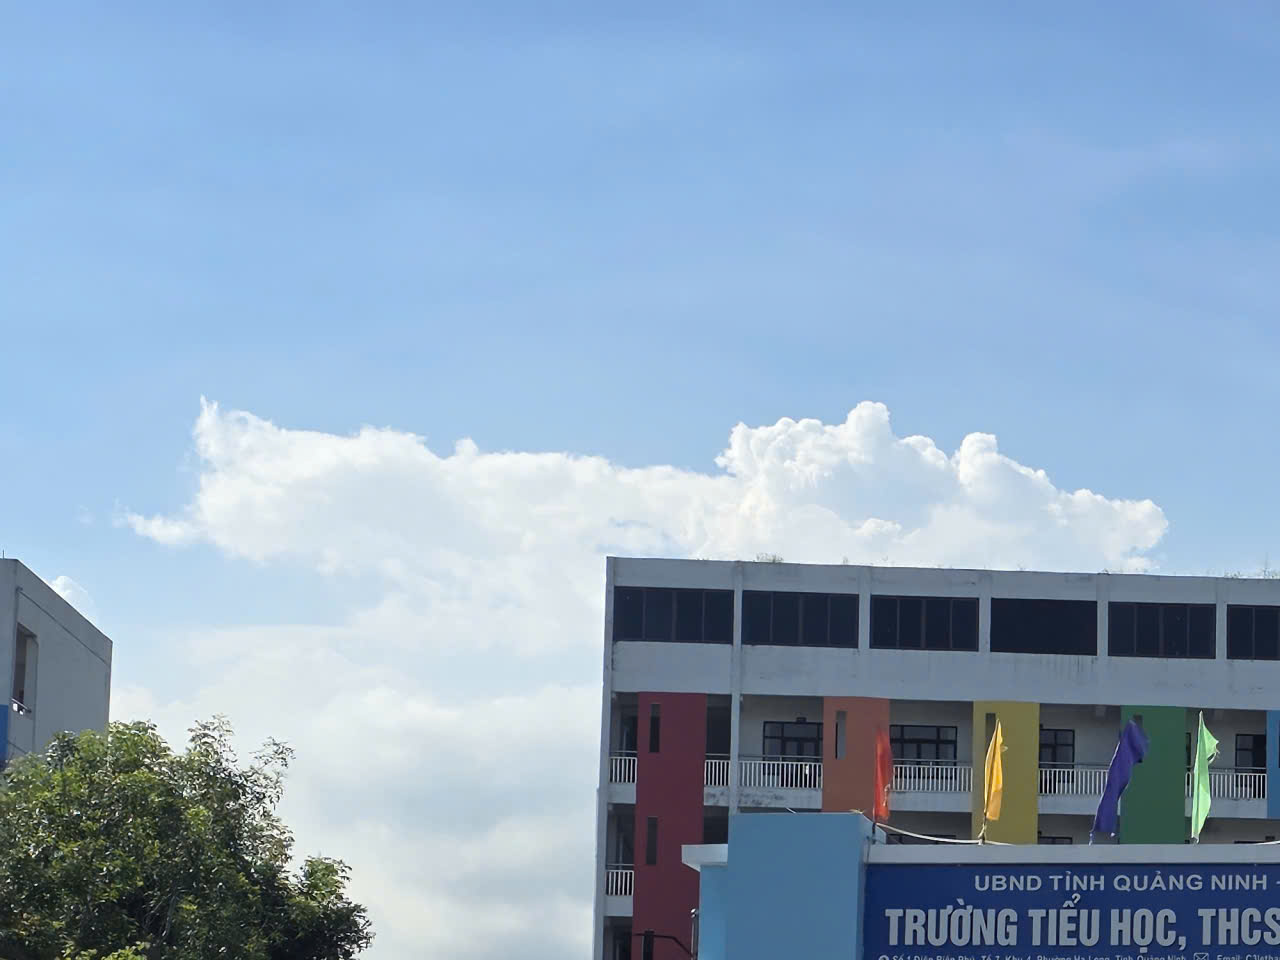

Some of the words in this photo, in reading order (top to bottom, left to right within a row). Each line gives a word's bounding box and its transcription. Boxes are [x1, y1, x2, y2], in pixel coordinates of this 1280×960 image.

[974, 874, 1042, 892] UBND
[1048, 870, 1105, 891] TỈNH
[1113, 870, 1203, 892] QUẢNG
[1210, 874, 1268, 891] NINH
[885, 898, 1018, 946] TRƯỜNG
[1028, 893, 1100, 946] TIỂU
[1110, 908, 1187, 953] HỌC,
